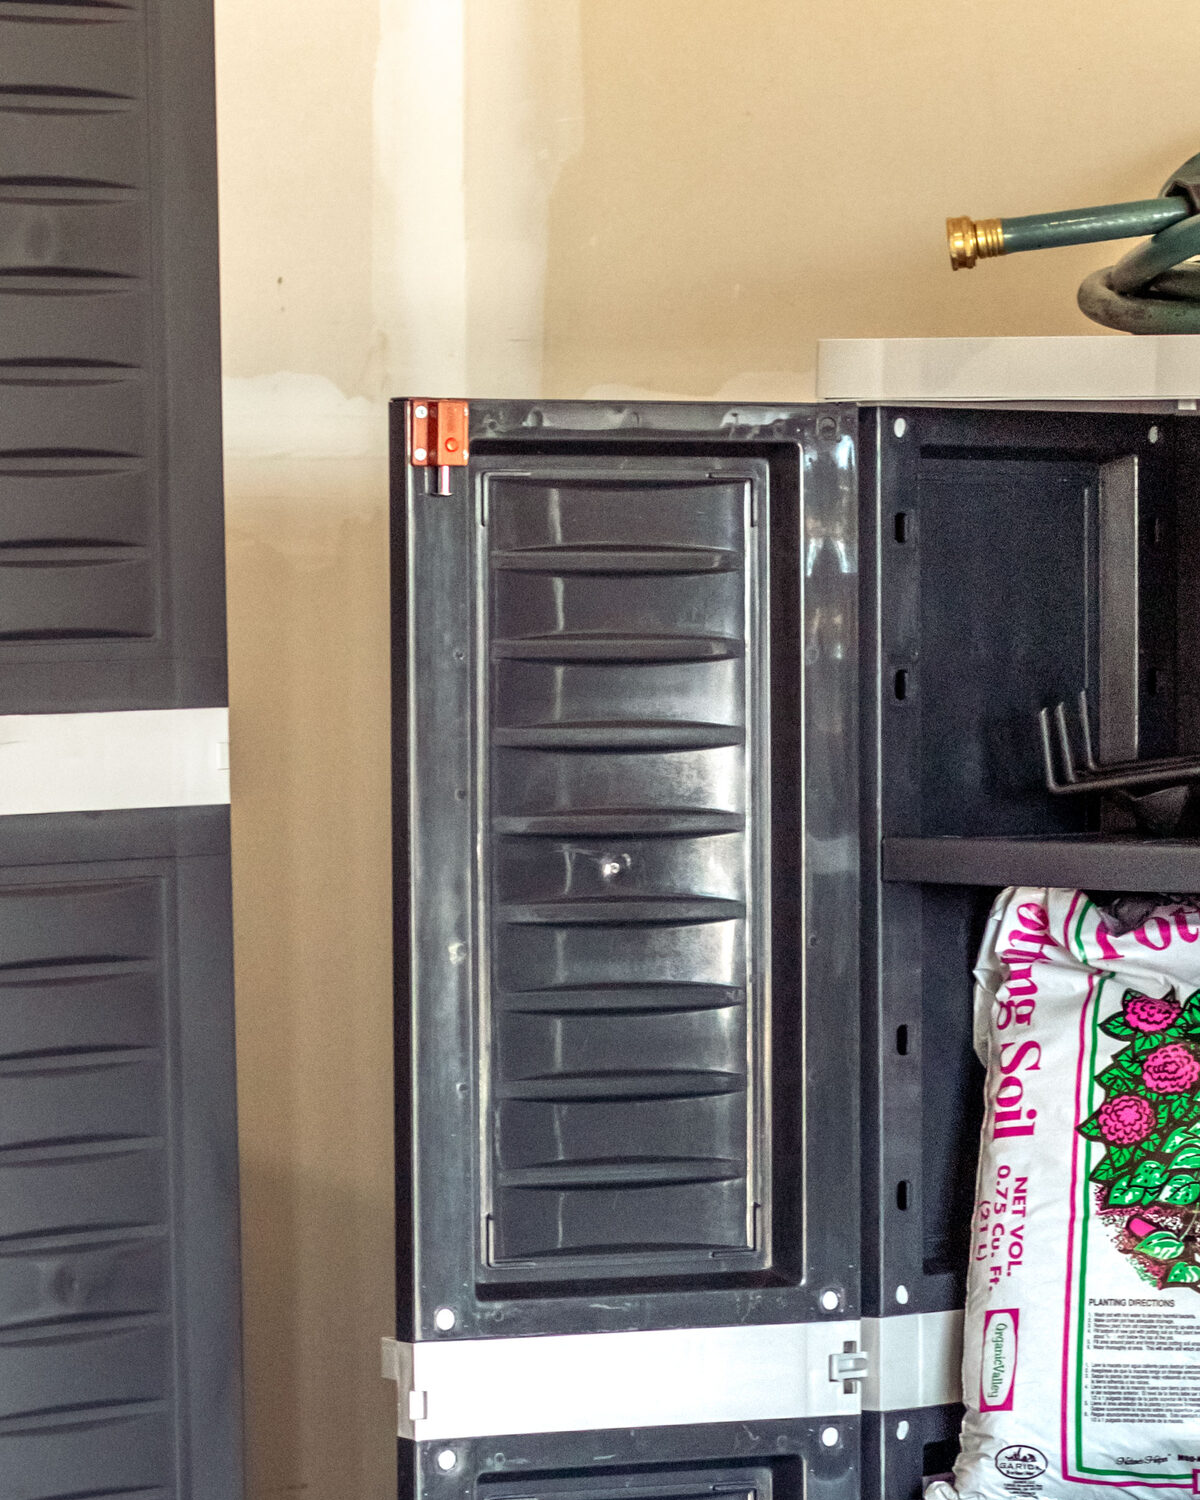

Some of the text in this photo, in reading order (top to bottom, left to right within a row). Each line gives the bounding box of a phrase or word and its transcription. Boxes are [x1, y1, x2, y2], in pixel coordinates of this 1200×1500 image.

[994, 902, 1060, 1139] otting Soil
[976, 1201, 991, 1261] (21 L)
[989, 1165, 1011, 1291] 0.75 Cu. Ft.
[1007, 1177, 1028, 1277] NET VOL.
[1089, 1299, 1176, 1307] PLANTING DIRECTIONS
